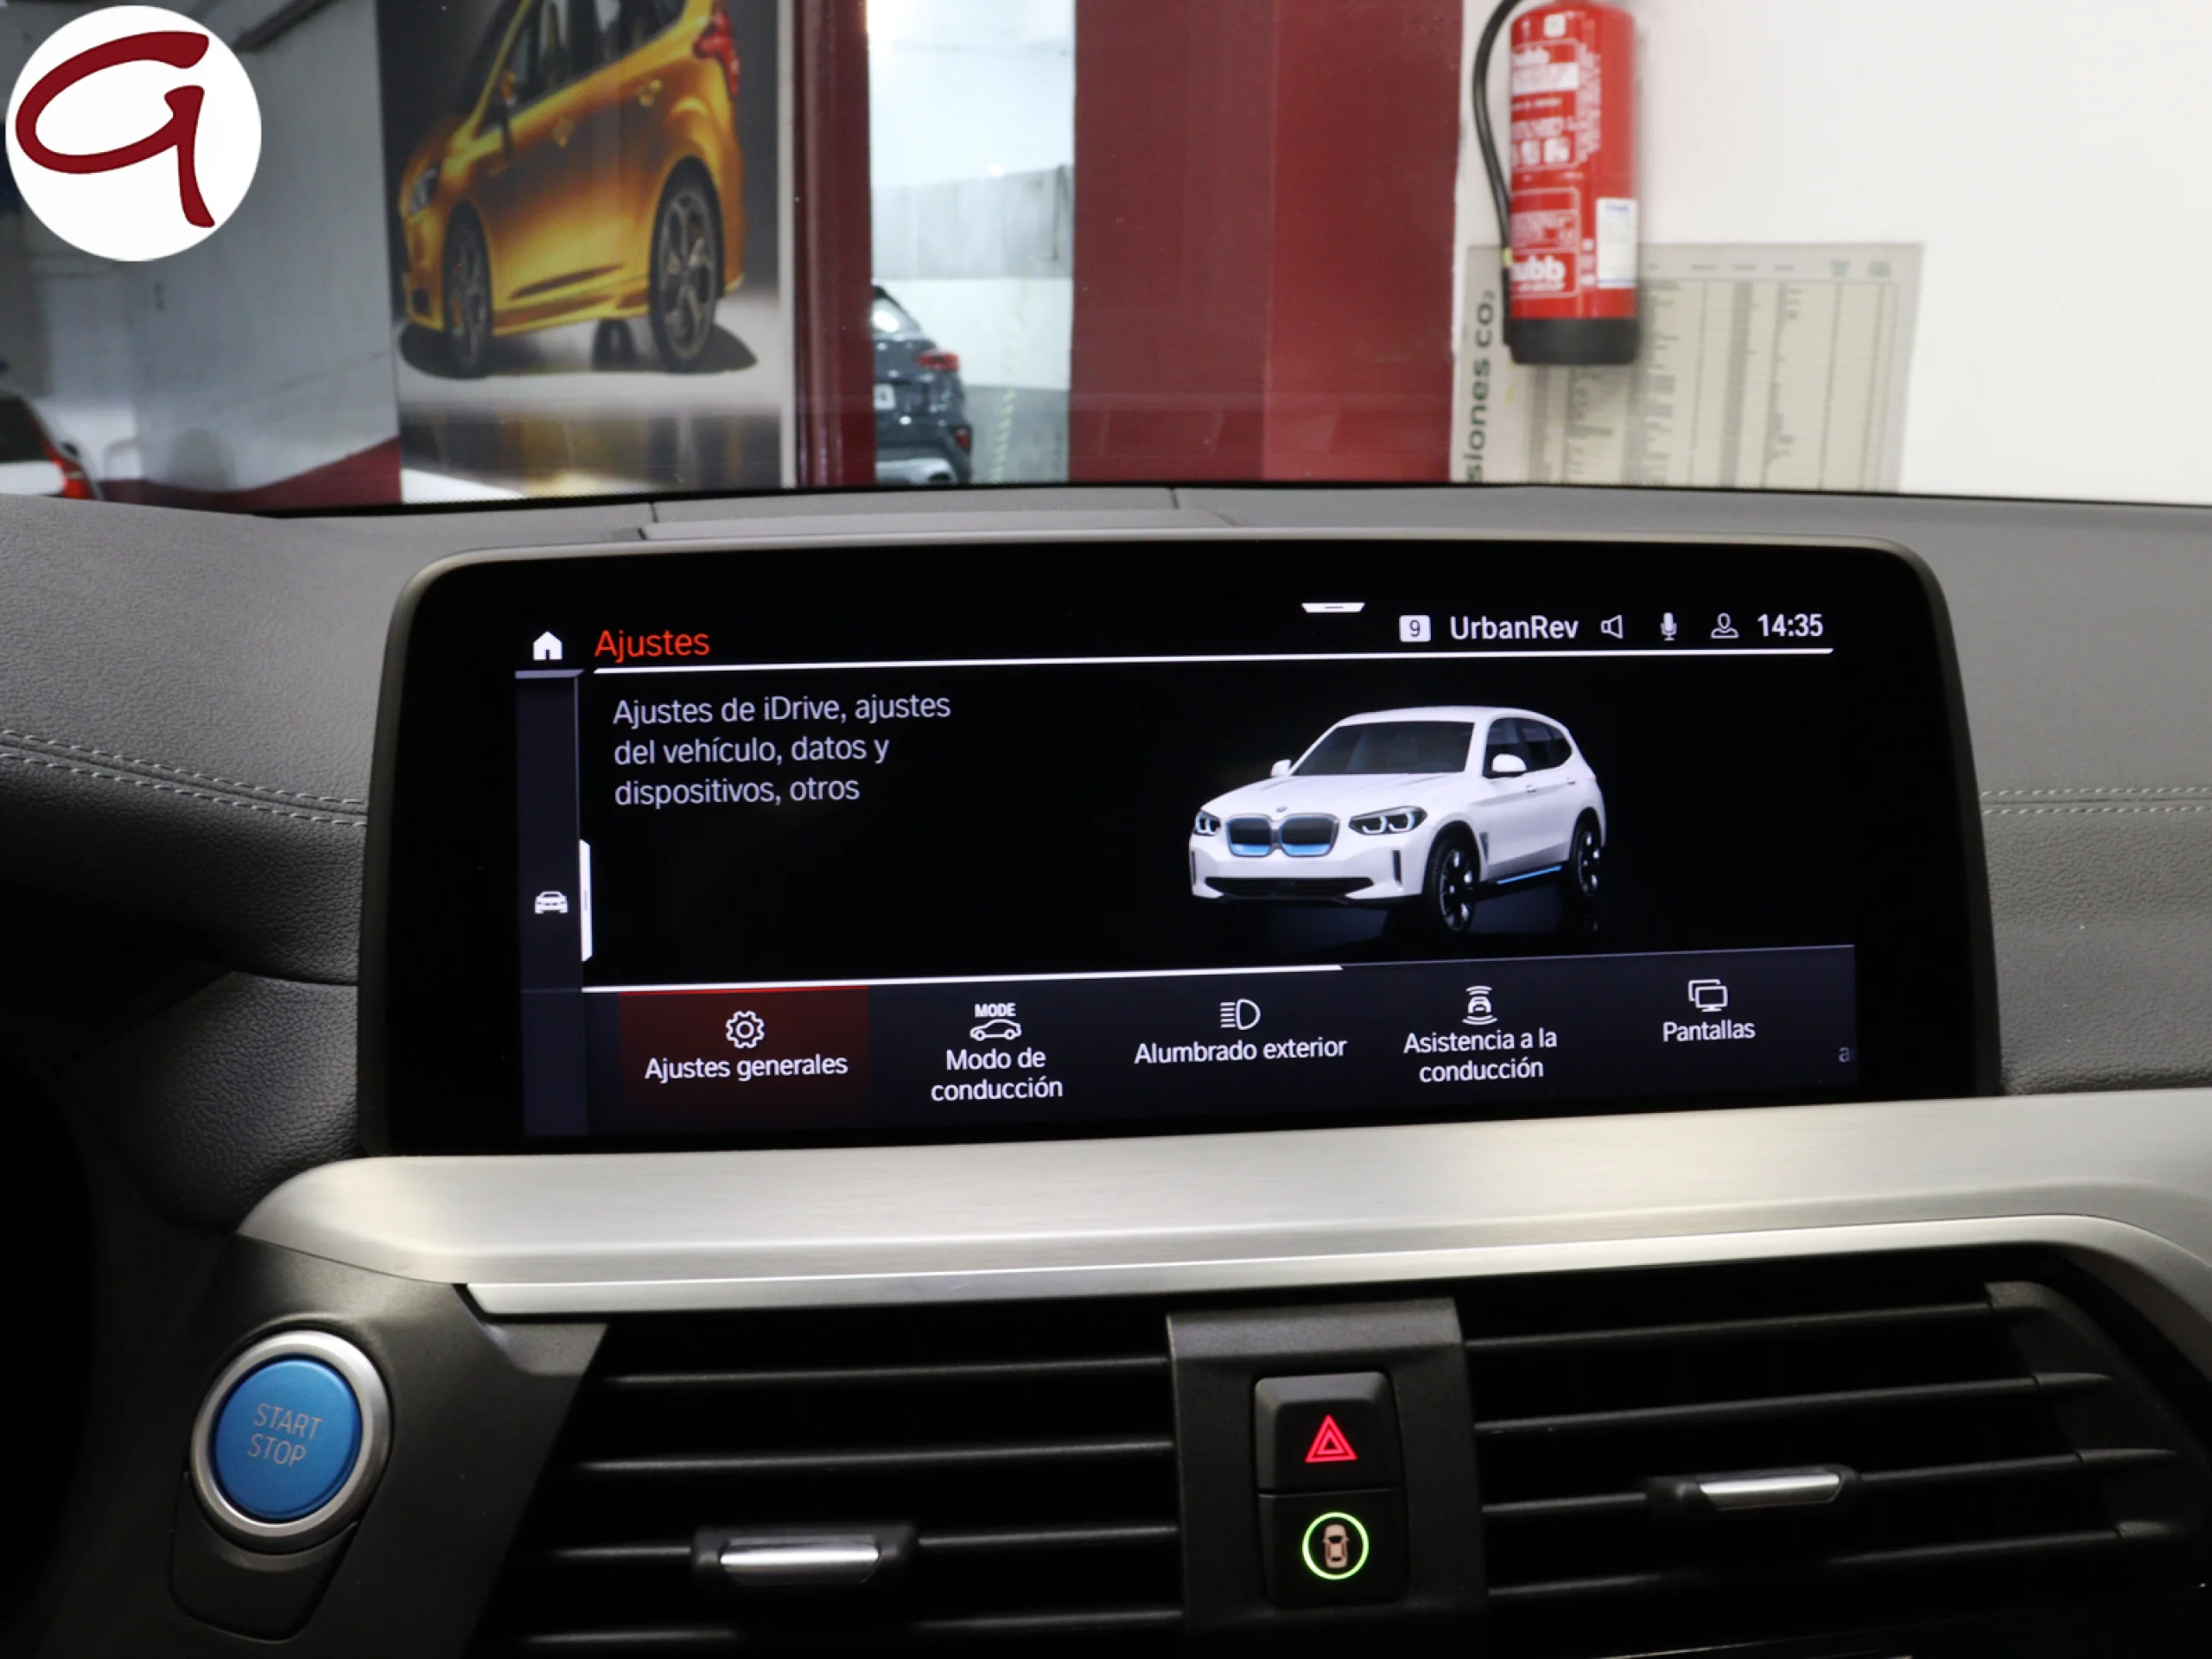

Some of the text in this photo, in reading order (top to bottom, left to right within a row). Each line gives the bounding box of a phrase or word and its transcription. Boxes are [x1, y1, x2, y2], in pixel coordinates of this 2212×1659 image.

[1409, 614, 1580, 640] 9 UrbanRev
[1758, 613, 1824, 637] 14:35
[594, 630, 710, 663] Ajustes
[613, 693, 951, 730] Ajustes de iDrive, ajustes
[614, 735, 890, 765] del vehículo, datos y
[614, 777, 861, 810] dispositivos, otros
[974, 1002, 1017, 1018] MODE
[1402, 1027, 1558, 1054] Asistencia a la
[1662, 1019, 1757, 1042] Pantallas
[946, 1046, 1047, 1071] Modo de
[1134, 1036, 1348, 1065] Alumbrado exterior
[1838, 1046, 1855, 1062] a
[645, 1053, 849, 1084] Ajustes generales
[1419, 1056, 1544, 1084] conducción
[931, 1075, 1064, 1102] conducción
[252, 1402, 324, 1440] START
[247, 1433, 307, 1467] STOP
